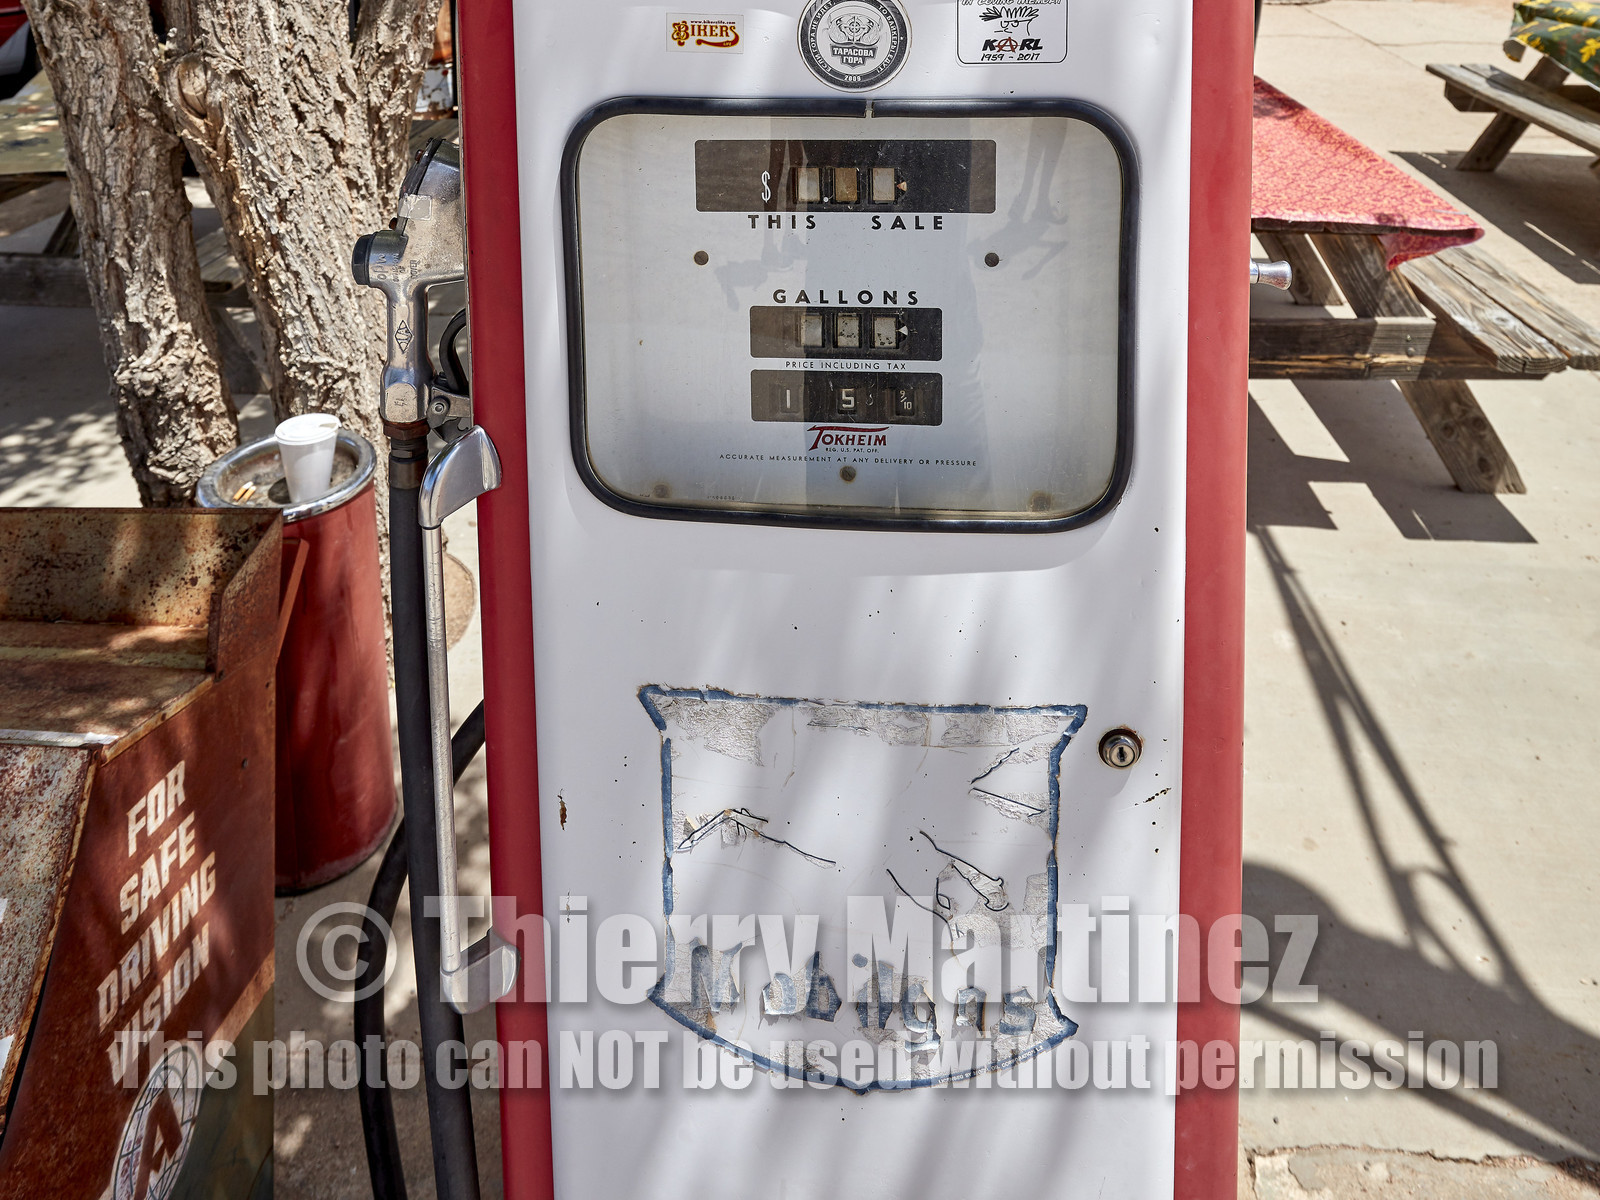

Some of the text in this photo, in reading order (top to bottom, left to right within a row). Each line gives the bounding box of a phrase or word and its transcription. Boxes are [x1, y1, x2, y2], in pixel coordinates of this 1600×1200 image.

[832, 46, 875, 58] ТАРАСОВА
[982, 36, 1044, 53] KARL
[843, 55, 864, 64] ГОРА
[980, 53, 1005, 62] 1959
[1016, 52, 1041, 61] 2017
[844, 74, 862, 82] 2009
[761, 170, 771, 203] $
[747, 214, 944, 231] THIS SALE
[772, 289, 919, 305] GALLONS
[785, 360, 907, 370] PRICE INCLUDING TAX
[841, 388, 855, 409] 5
[807, 424, 890, 451] TOKHEIM
[719, 453, 764, 461] ACCURATE
[127, 760, 187, 858] FOR
[119, 810, 196, 936] SAFE
[97, 850, 217, 1034] DRIVING
[106, 921, 210, 1087] VISION
